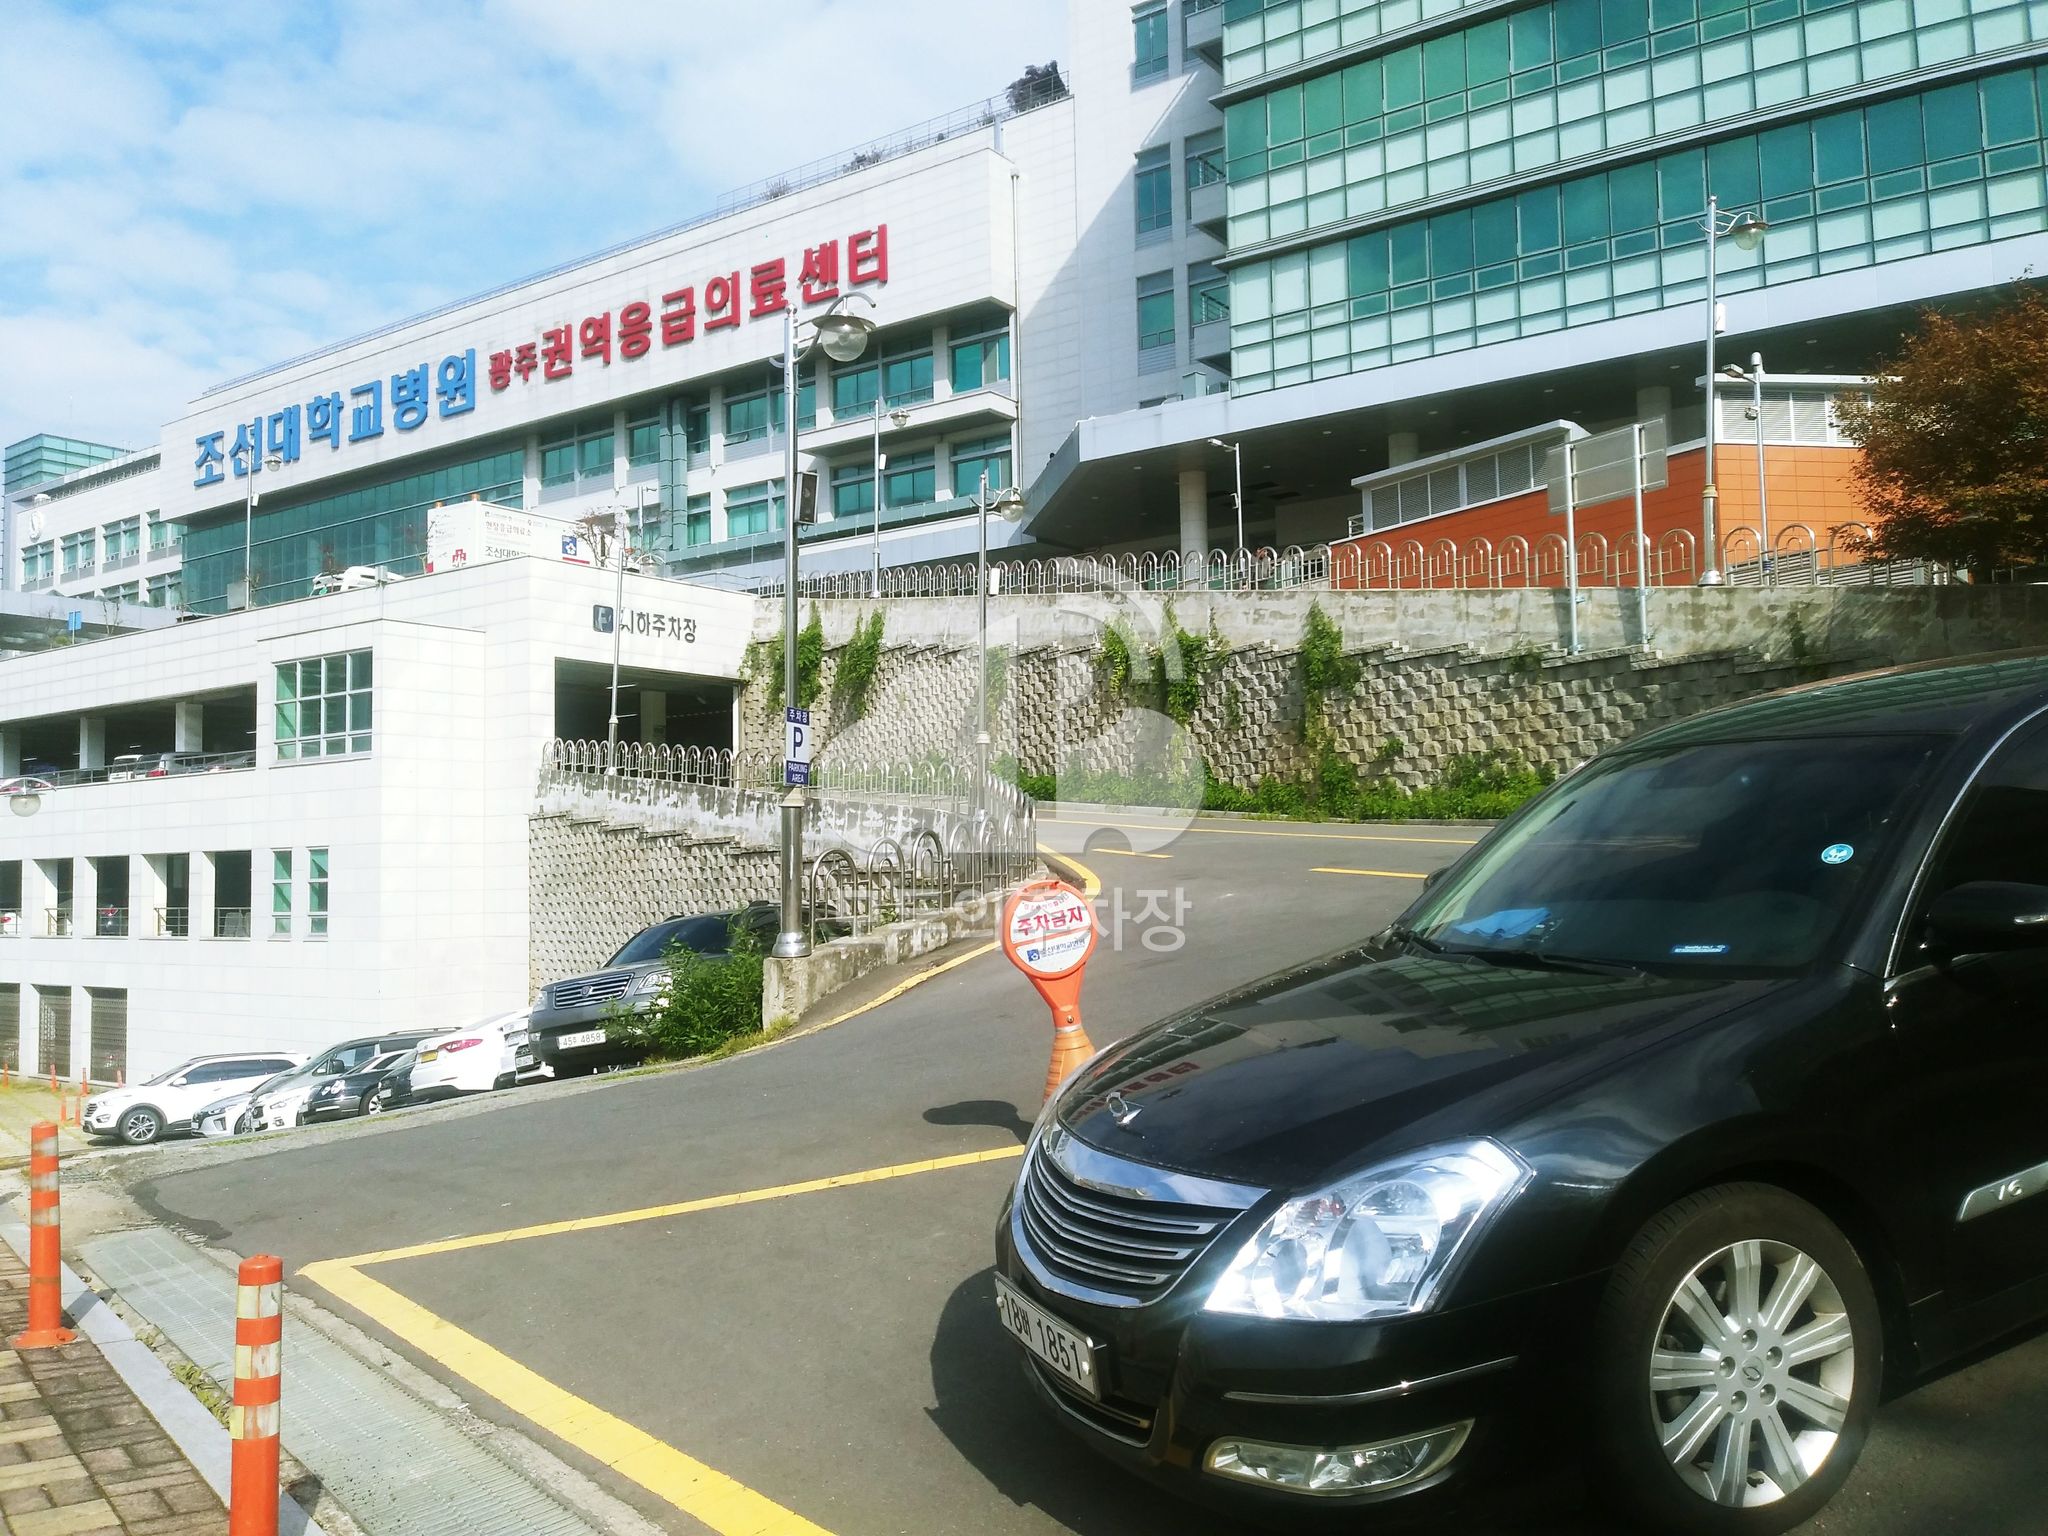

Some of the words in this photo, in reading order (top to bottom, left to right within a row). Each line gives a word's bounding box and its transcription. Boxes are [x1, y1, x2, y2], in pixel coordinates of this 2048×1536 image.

[194, 348, 475, 487] 조선대학교병원
[793, 726, 804, 758] P
[788, 763, 808, 773] PARKING
[791, 772, 804, 783] AREA
[1017, 905, 1083, 936] 주차금지
[1036, 1318, 1081, 1380] 1851
